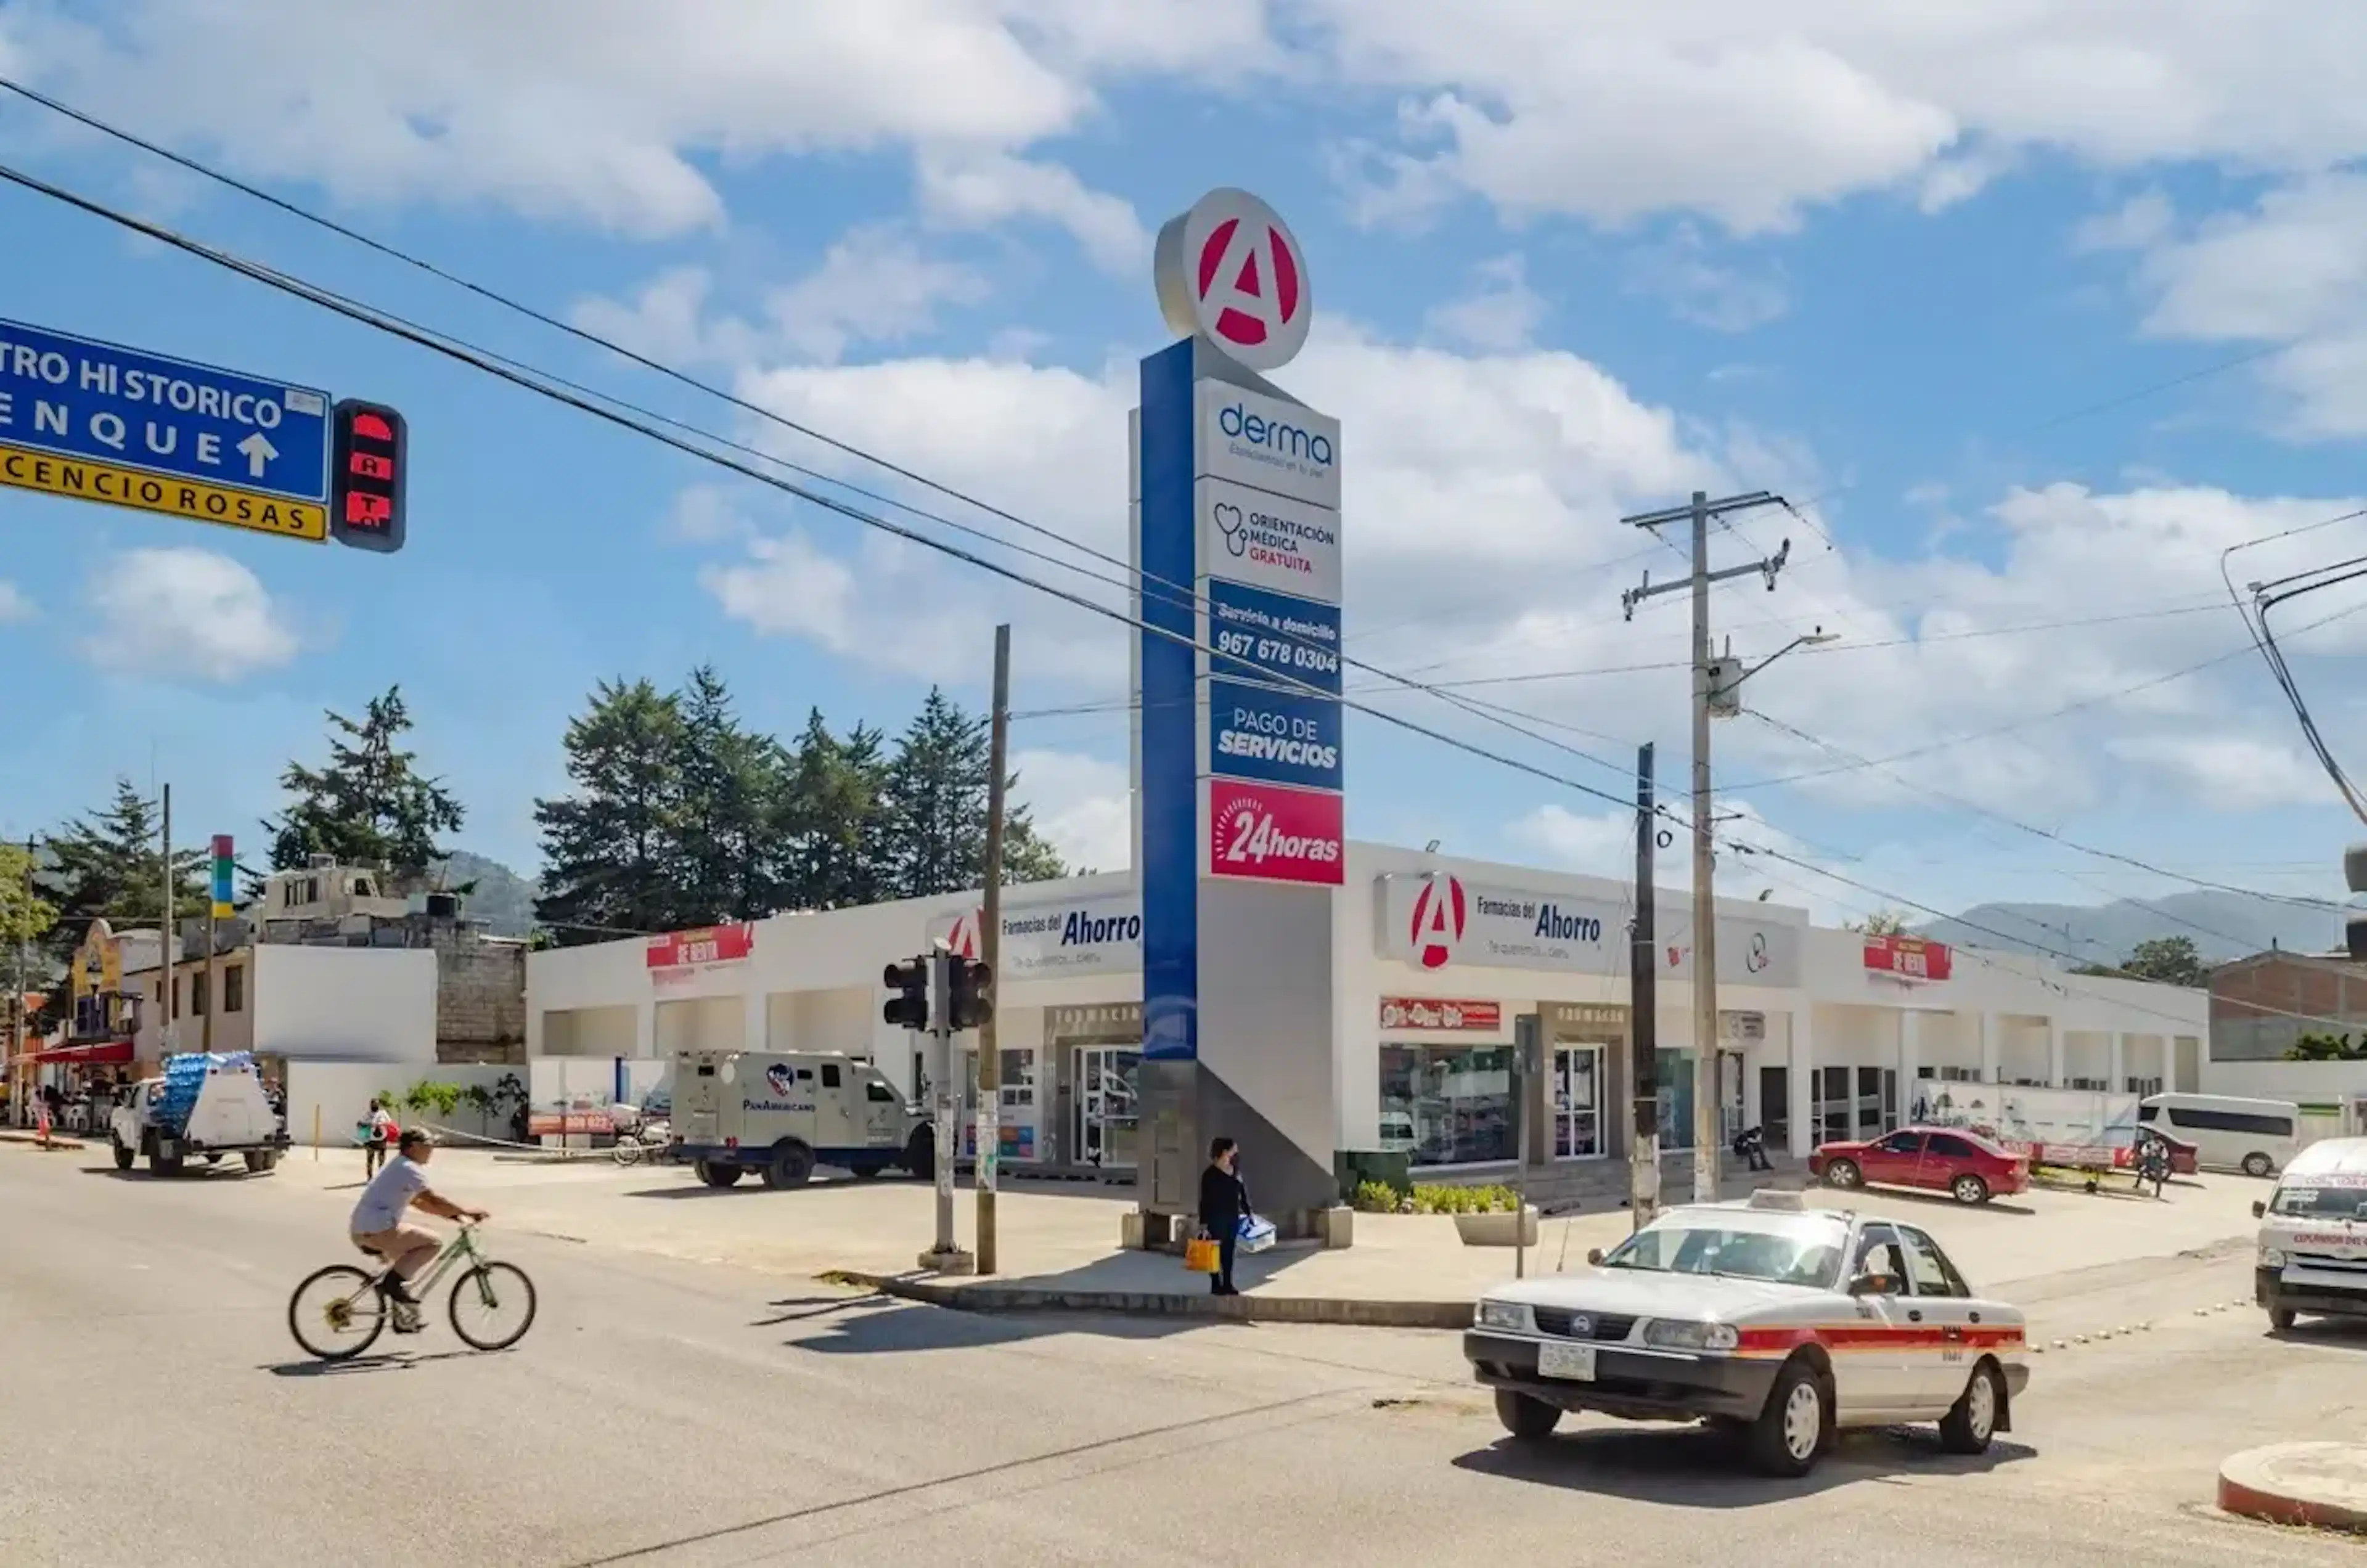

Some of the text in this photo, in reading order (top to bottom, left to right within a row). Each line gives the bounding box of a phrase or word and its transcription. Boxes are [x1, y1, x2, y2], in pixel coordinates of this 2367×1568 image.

[1220, 402, 1332, 465] derma
[6, 455, 305, 530] CENCIO ROSAS
[1250, 513, 1334, 545] ORIENTACIÓN
[1250, 529, 1298, 553] MÉDICA
[1249, 547, 1312, 574] GRATUITA
[1218, 602, 1336, 640] Servicio a domicilio
[1218, 630, 1338, 674] 967 678 0304
[1233, 707, 1318, 740] PAGO DE
[1218, 729, 1338, 769] SERVICIOS
[1061, 910, 1140, 946] Ahorro
[1477, 896, 1601, 942] Farmacias del Ahorro
